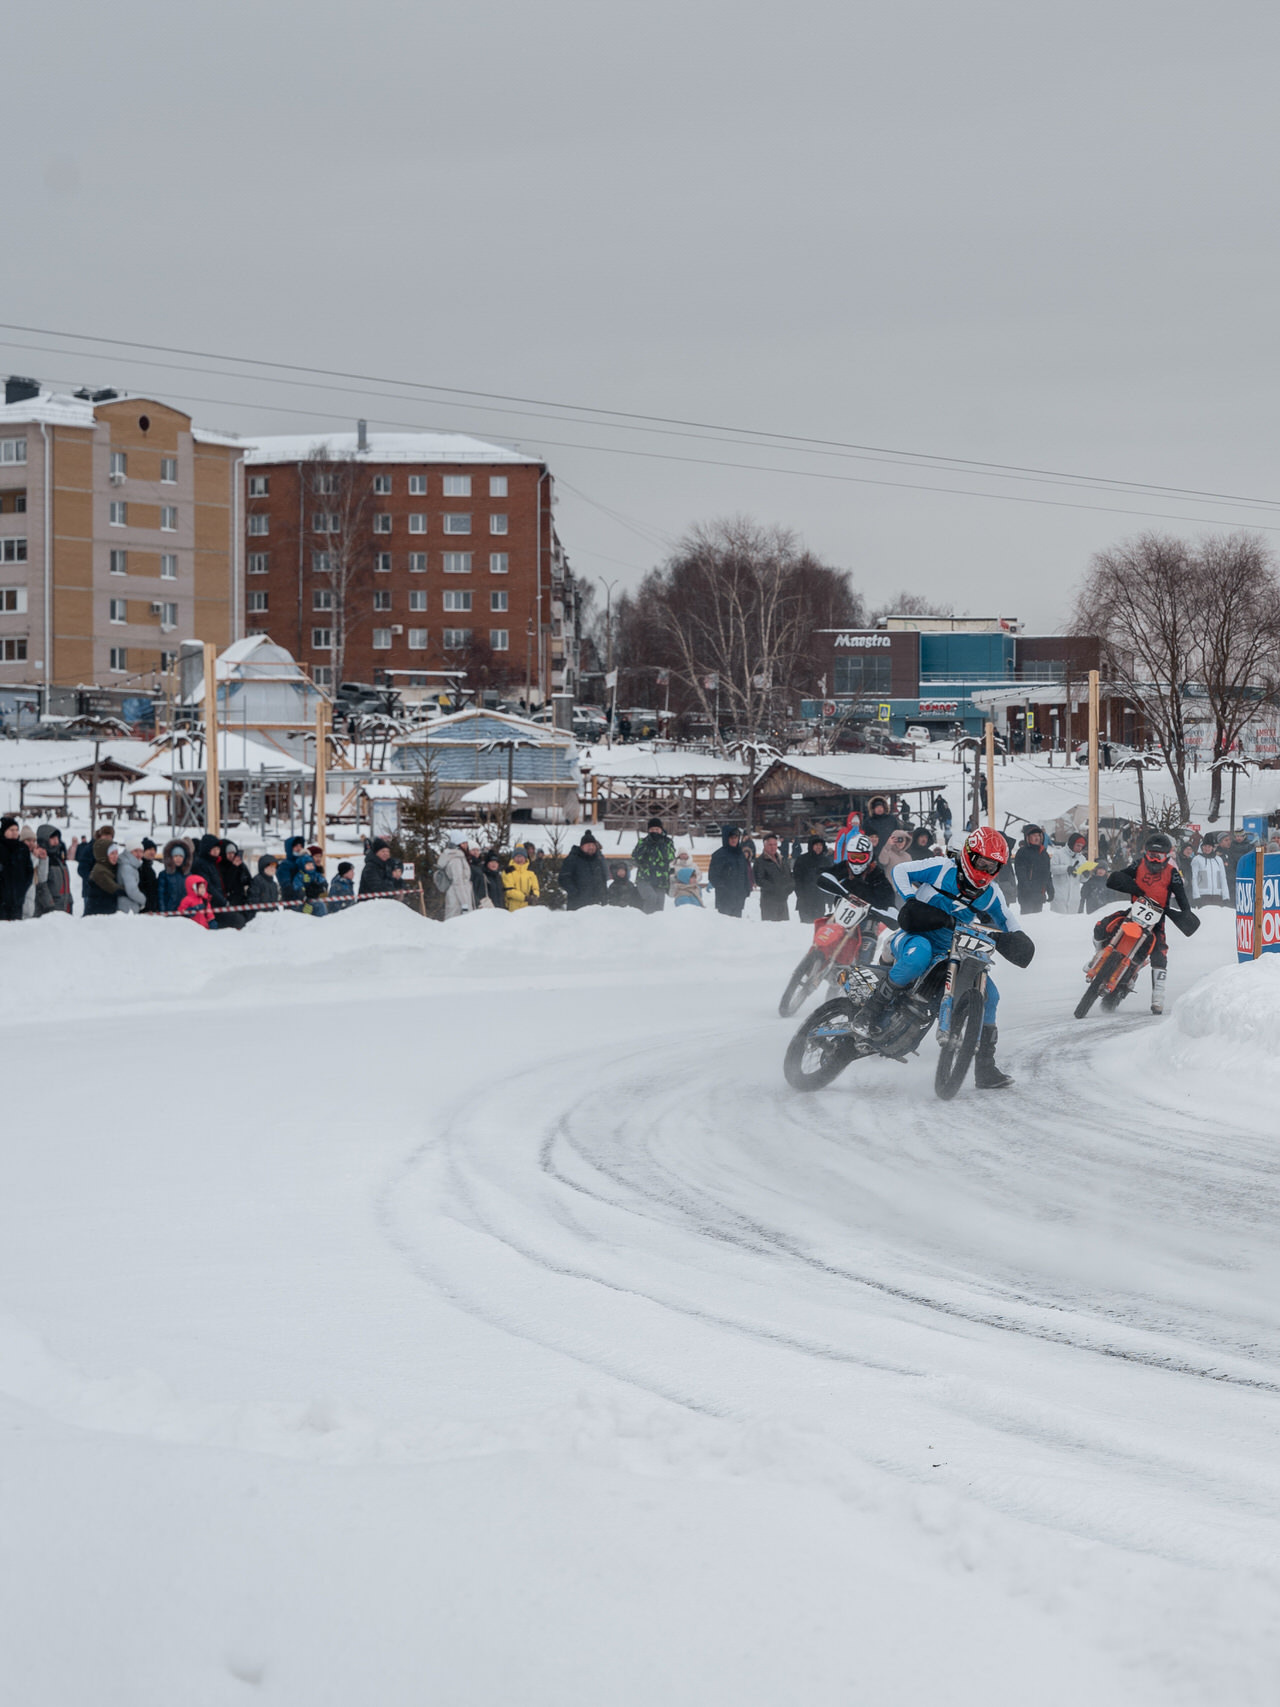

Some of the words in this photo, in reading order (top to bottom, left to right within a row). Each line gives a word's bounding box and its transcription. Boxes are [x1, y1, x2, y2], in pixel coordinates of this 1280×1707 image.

[839, 907, 856, 925] 18
[1137, 906, 1154, 921] 76
[957, 934, 994, 952] 117
